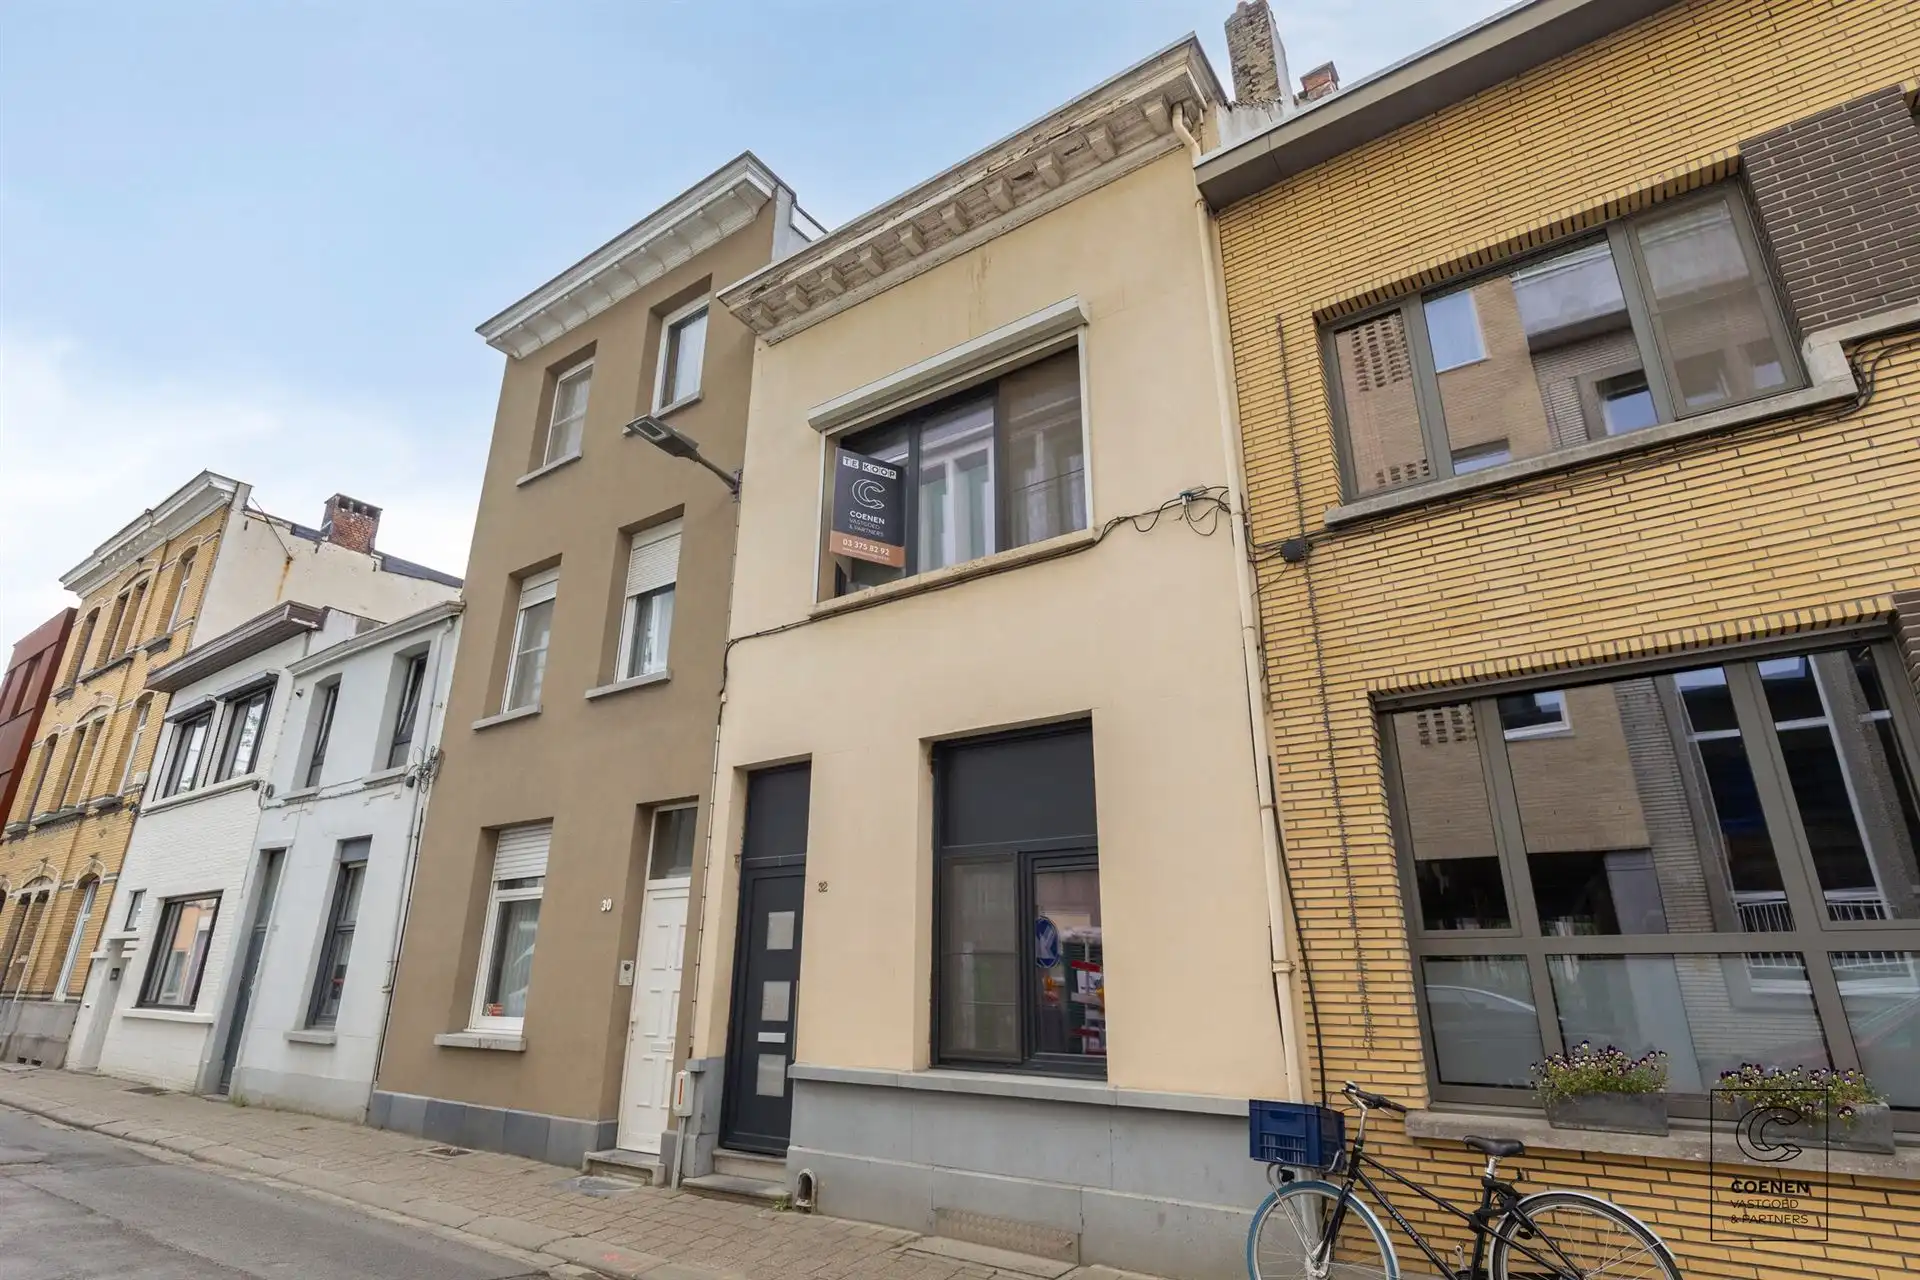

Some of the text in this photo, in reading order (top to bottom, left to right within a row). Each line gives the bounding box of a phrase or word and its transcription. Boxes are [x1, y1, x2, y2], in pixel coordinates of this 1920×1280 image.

[843, 456, 896, 479] TE KOOP
[849, 510, 885, 525] COENEN
[842, 538, 852, 547] 03
[854, 541, 868, 551] 375
[869, 545, 879, 553] 82
[880, 547, 890, 557] 92
[818, 881, 828, 893] 32
[601, 898, 612, 911] 30
